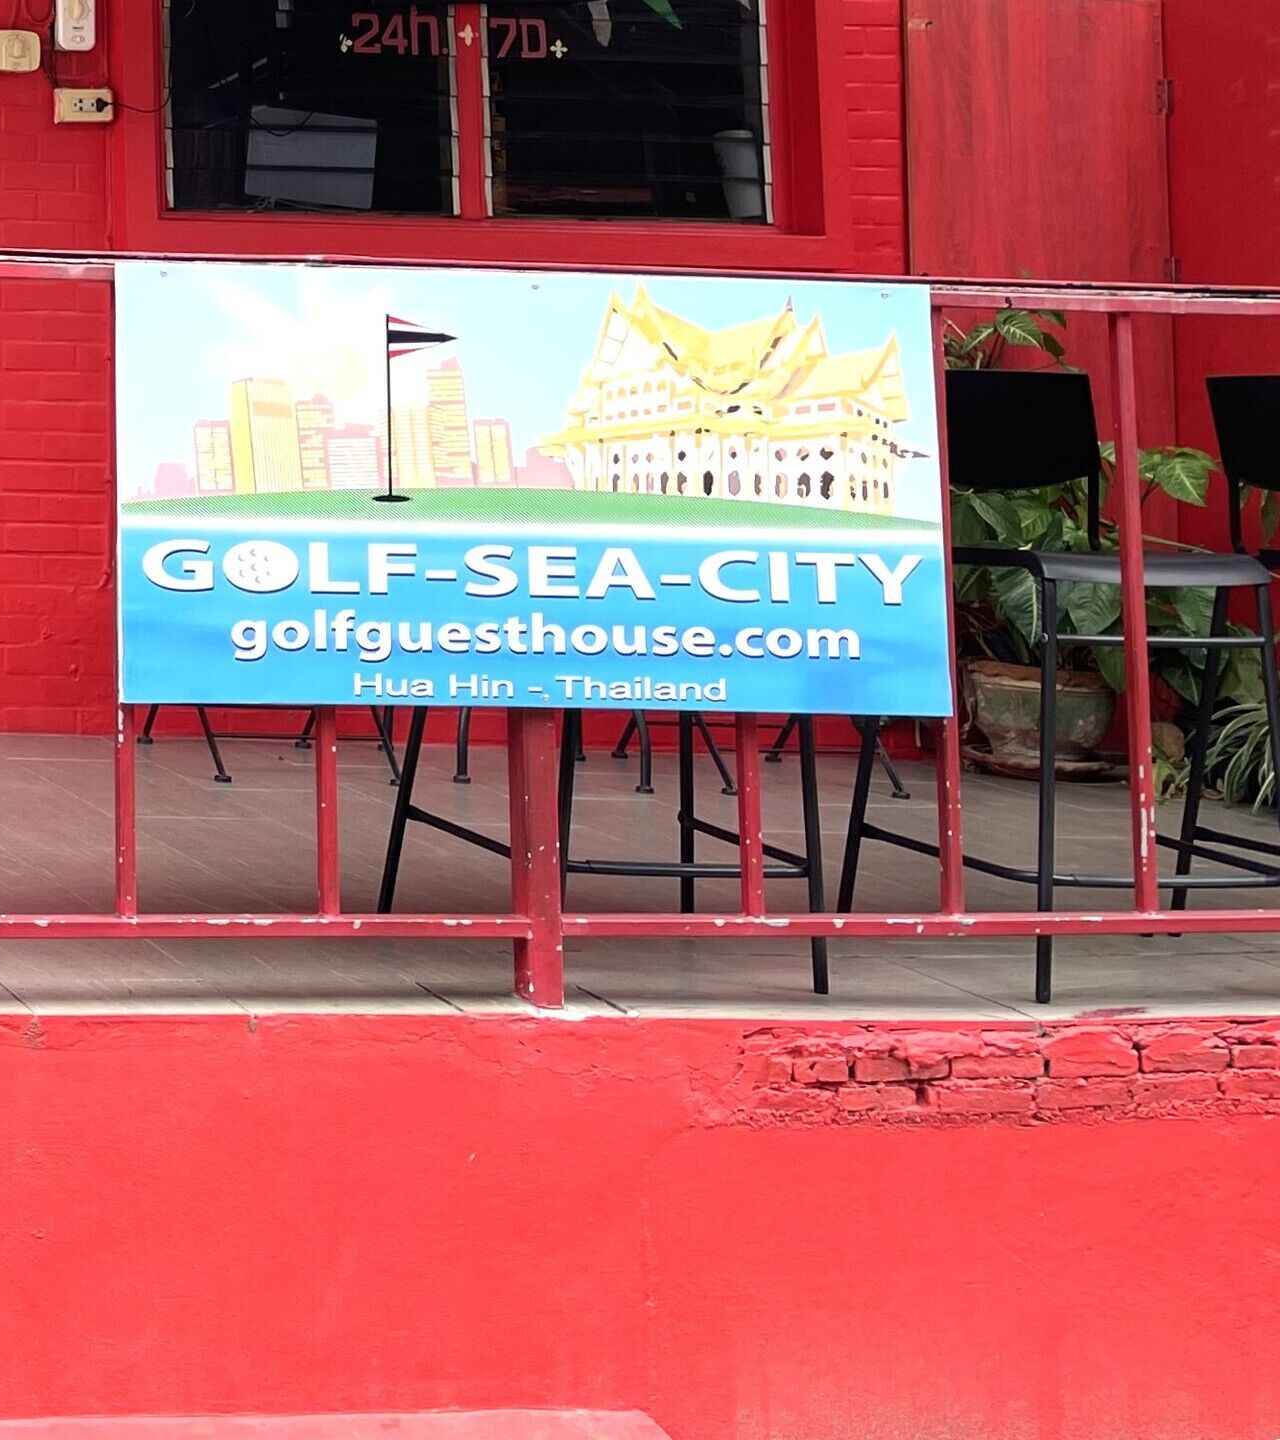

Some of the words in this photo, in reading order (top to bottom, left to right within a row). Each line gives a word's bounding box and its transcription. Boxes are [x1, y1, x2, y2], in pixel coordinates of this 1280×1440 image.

[490, 17, 548, 59] 7D
[142, 538, 924, 606] GOLF-SEA-CITY
[229, 608, 862, 663] golfguesthouse.com
[352, 672, 435, 699] Hua
[448, 673, 515, 699] Hin
[554, 674, 728, 703] Thailand
